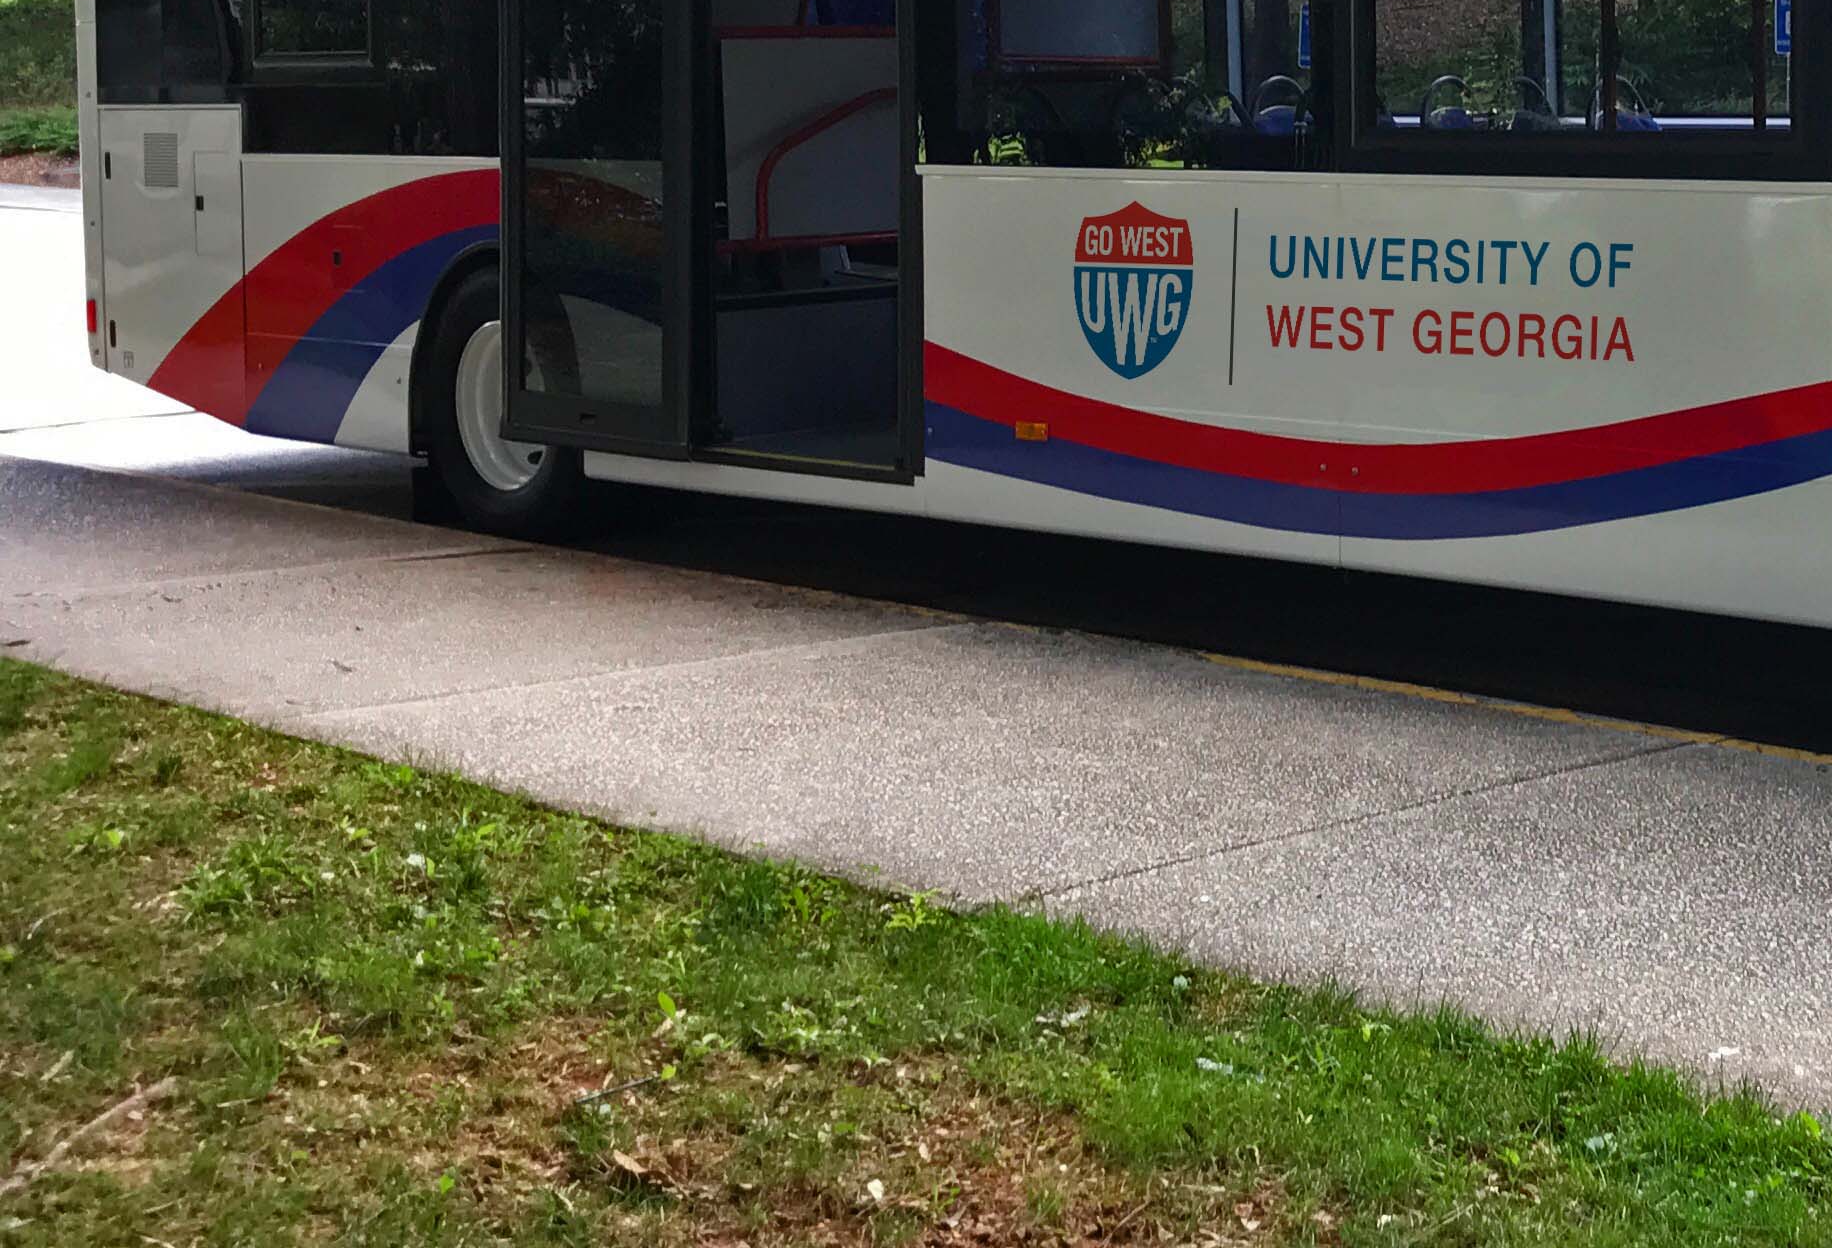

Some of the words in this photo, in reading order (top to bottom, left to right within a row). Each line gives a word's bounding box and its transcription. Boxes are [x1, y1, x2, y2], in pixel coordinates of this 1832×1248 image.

[1085, 225, 1113, 256] GO
[1120, 226, 1184, 257] WEST
[1270, 235, 1550, 285] UNIVERSITY
[1569, 242, 1634, 288] OF
[1081, 271, 1183, 366] UWG
[1266, 304, 1394, 352] WEST
[1412, 309, 1635, 362] GEORGIA
